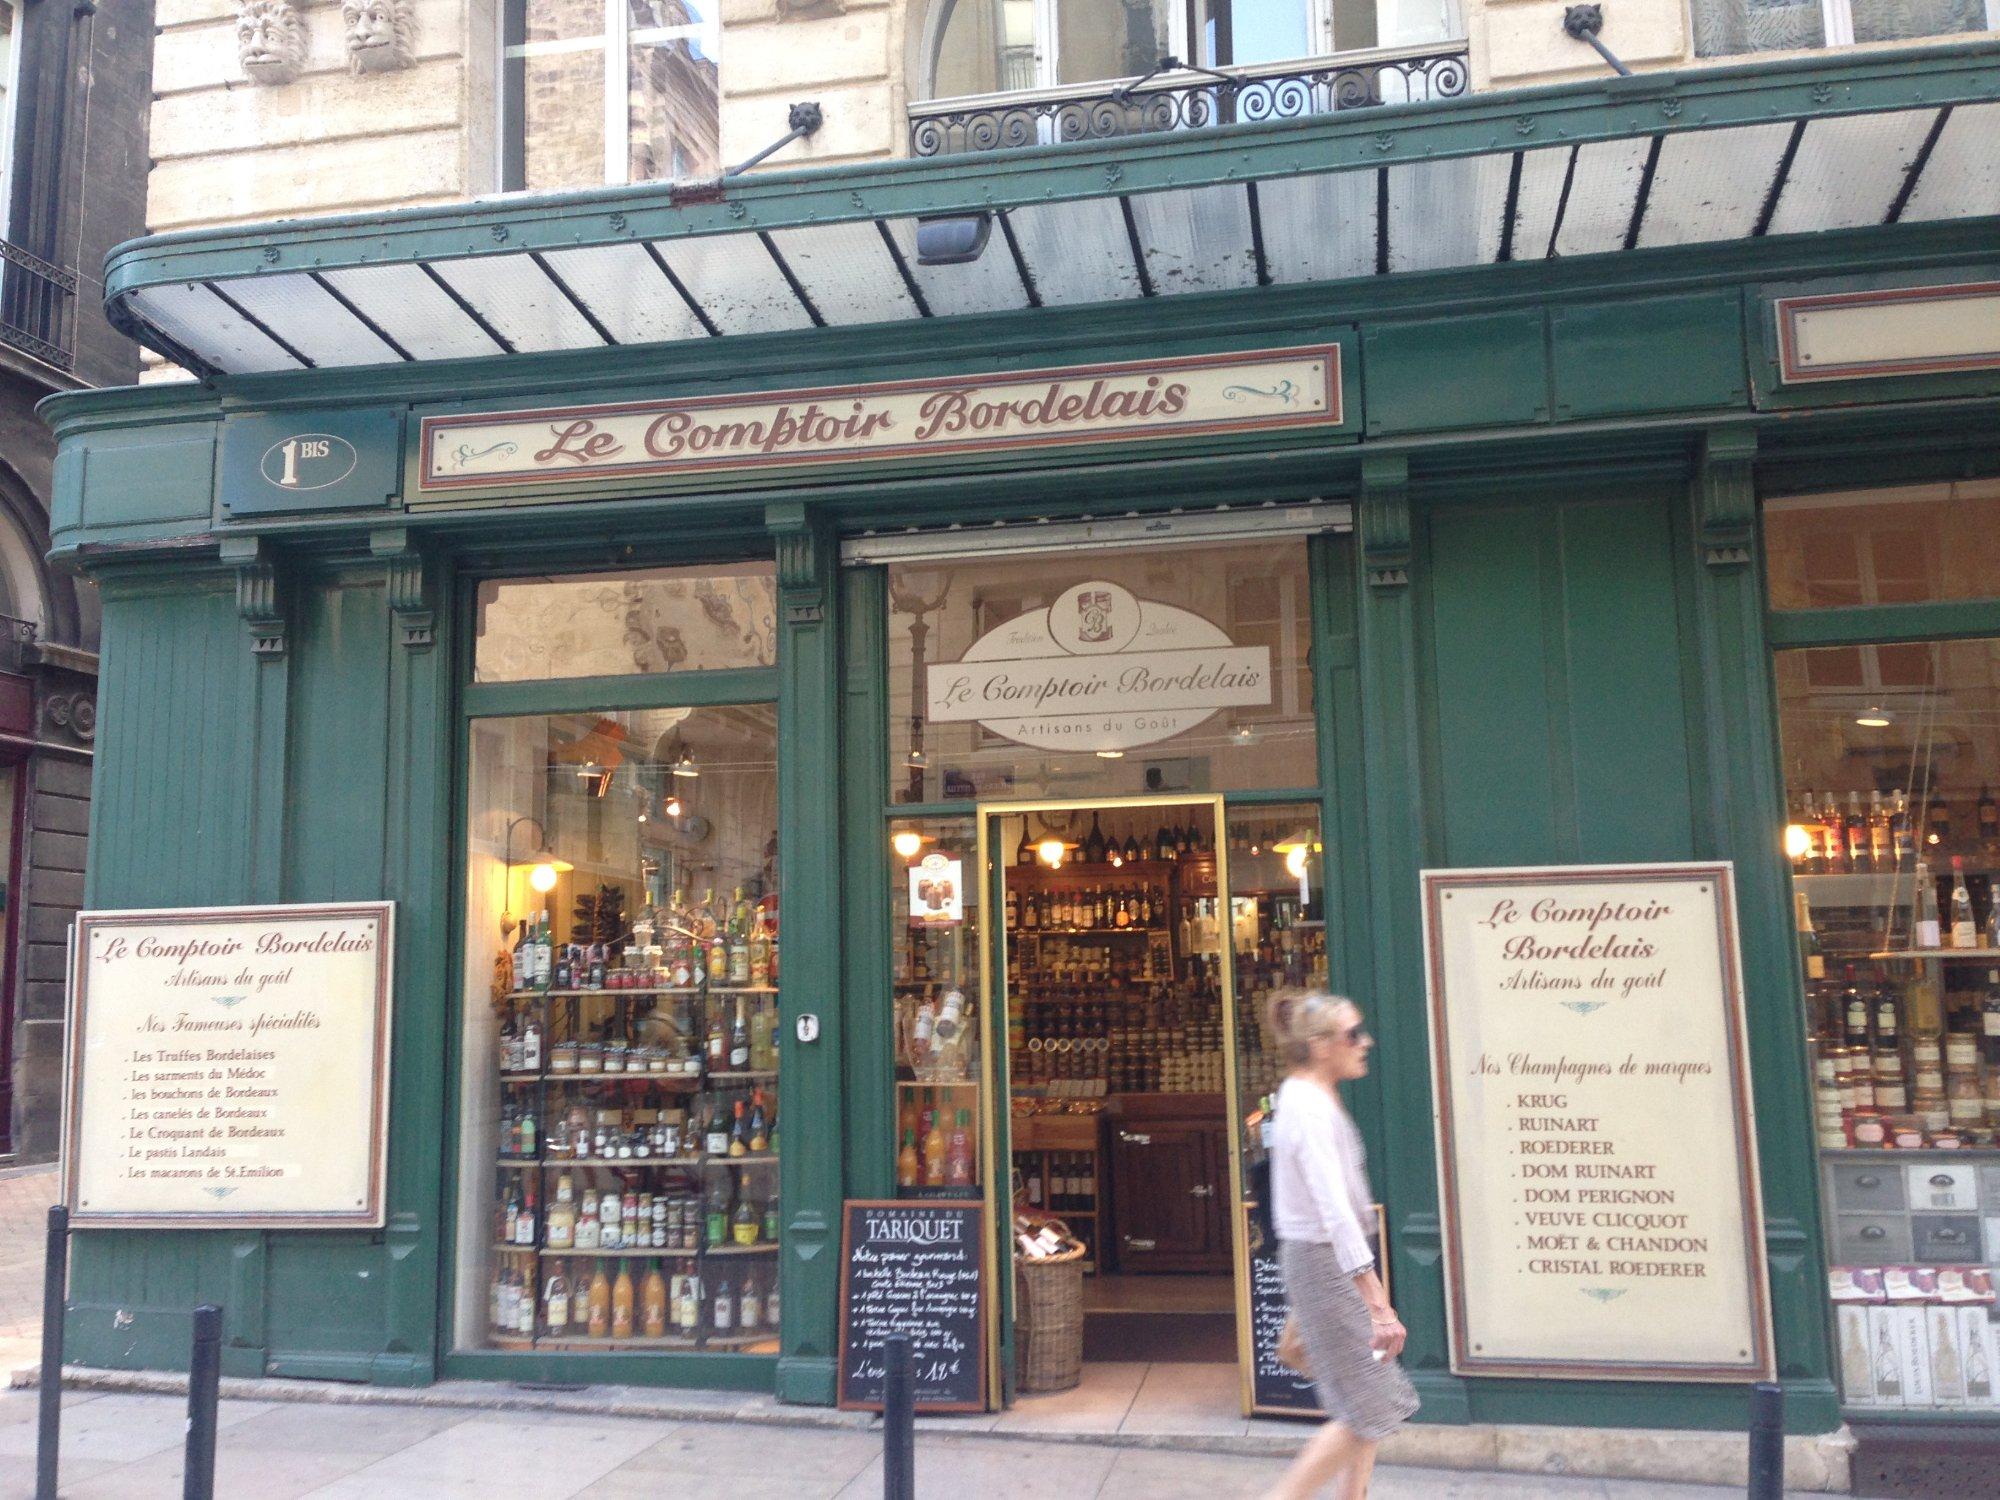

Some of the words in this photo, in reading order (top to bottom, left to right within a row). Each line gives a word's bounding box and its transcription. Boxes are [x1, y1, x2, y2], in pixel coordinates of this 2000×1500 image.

[534, 420, 622, 465] Le
[644, 398, 890, 459] Comptoir
[915, 376, 1188, 439] Bordelais
[280, 441, 297, 484] 1
[300, 440, 329, 457] BIS
[935, 677, 974, 709] Le
[982, 673, 1109, 708] Comptoir
[1117, 663, 1260, 693] Bordelais
[1018, 722, 1091, 735] Artisans
[1104, 719, 1122, 731] du
[1135, 716, 1177, 729] Goût
[1478, 899, 1521, 928] Le
[1530, 898, 1671, 930] Comptoir
[97, 938, 127, 963] Le
[136, 935, 243, 964] Comptoir
[256, 932, 373, 955] Bordelais
[1503, 934, 1657, 960] Bordelais
[165, 970, 228, 988] Artisans
[234, 968, 253, 986] du
[257, 968, 292, 992] goût
[1500, 968, 1582, 989] Artisans
[1591, 968, 1615, 989] du
[1623, 968, 1666, 997] goût
[136, 1014, 165, 1033] Nos
[172, 1012, 243, 1032] Fameuses
[249, 1010, 321, 1037] spécialités
[133, 1050, 151, 1062] Les
[156, 1049, 201, 1062] Truffes
[207, 1048, 275, 1062] Bordelaises
[132, 1070, 149, 1082] Les
[154, 1071, 203, 1081] sarments
[209, 1069, 222, 1080] du
[227, 1067, 265, 1079] Médoc
[1471, 1054, 1501, 1075] Nos
[1507, 1052, 1612, 1084] Champagnes
[1619, 1054, 1637, 1075] de
[1645, 1061, 1711, 1083] marques
[132, 1089, 145, 1100] les
[151, 1088, 203, 1099] bouchons
[209, 1087, 221, 1098] de
[225, 1086, 278, 1098] Bordeaux
[1517, 1095, 1567, 1108] KRUG
[131, 1108, 148, 1120] Les
[153, 1108, 192, 1120] canelés
[197, 1108, 210, 1119] de
[214, 1107, 267, 1119] Bordeaux
[1519, 1118, 1599, 1131] RUINART
[130, 1127, 142, 1139] Le
[148, 1126, 204, 1142] Croquant
[210, 1126, 223, 1138] de
[229, 1126, 284, 1138] Bordeaux
[129, 1147, 141, 1158] Le
[145, 1147, 177, 1160] pastis
[182, 1146, 226, 1158] Landais
[1521, 1142, 1614, 1155] ROEDERER
[128, 1167, 145, 1178] Les
[150, 1168, 203, 1178] macarons
[208, 1166, 220, 1177] de
[1523, 1165, 1568, 1178] DOM
[1576, 1165, 1657, 1179] RUINART
[1526, 1190, 1570, 1203] DOM
[1579, 1191, 1675, 1204] PERIGNON
[866, 1210, 935, 1218] DOMAINE
[1525, 1212, 1586, 1226] VEUVE
[1593, 1214, 1688, 1230] CLICQUOT
[865, 1220, 964, 1245] TARIQUET
[1528, 1234, 1579, 1250] MOËT
[1587, 1237, 1600, 1250] &
[1607, 1237, 1708, 1252] CHANDON
[1529, 1260, 1603, 1274] CRISTAL
[1610, 1261, 1707, 1277] ROEDERER
